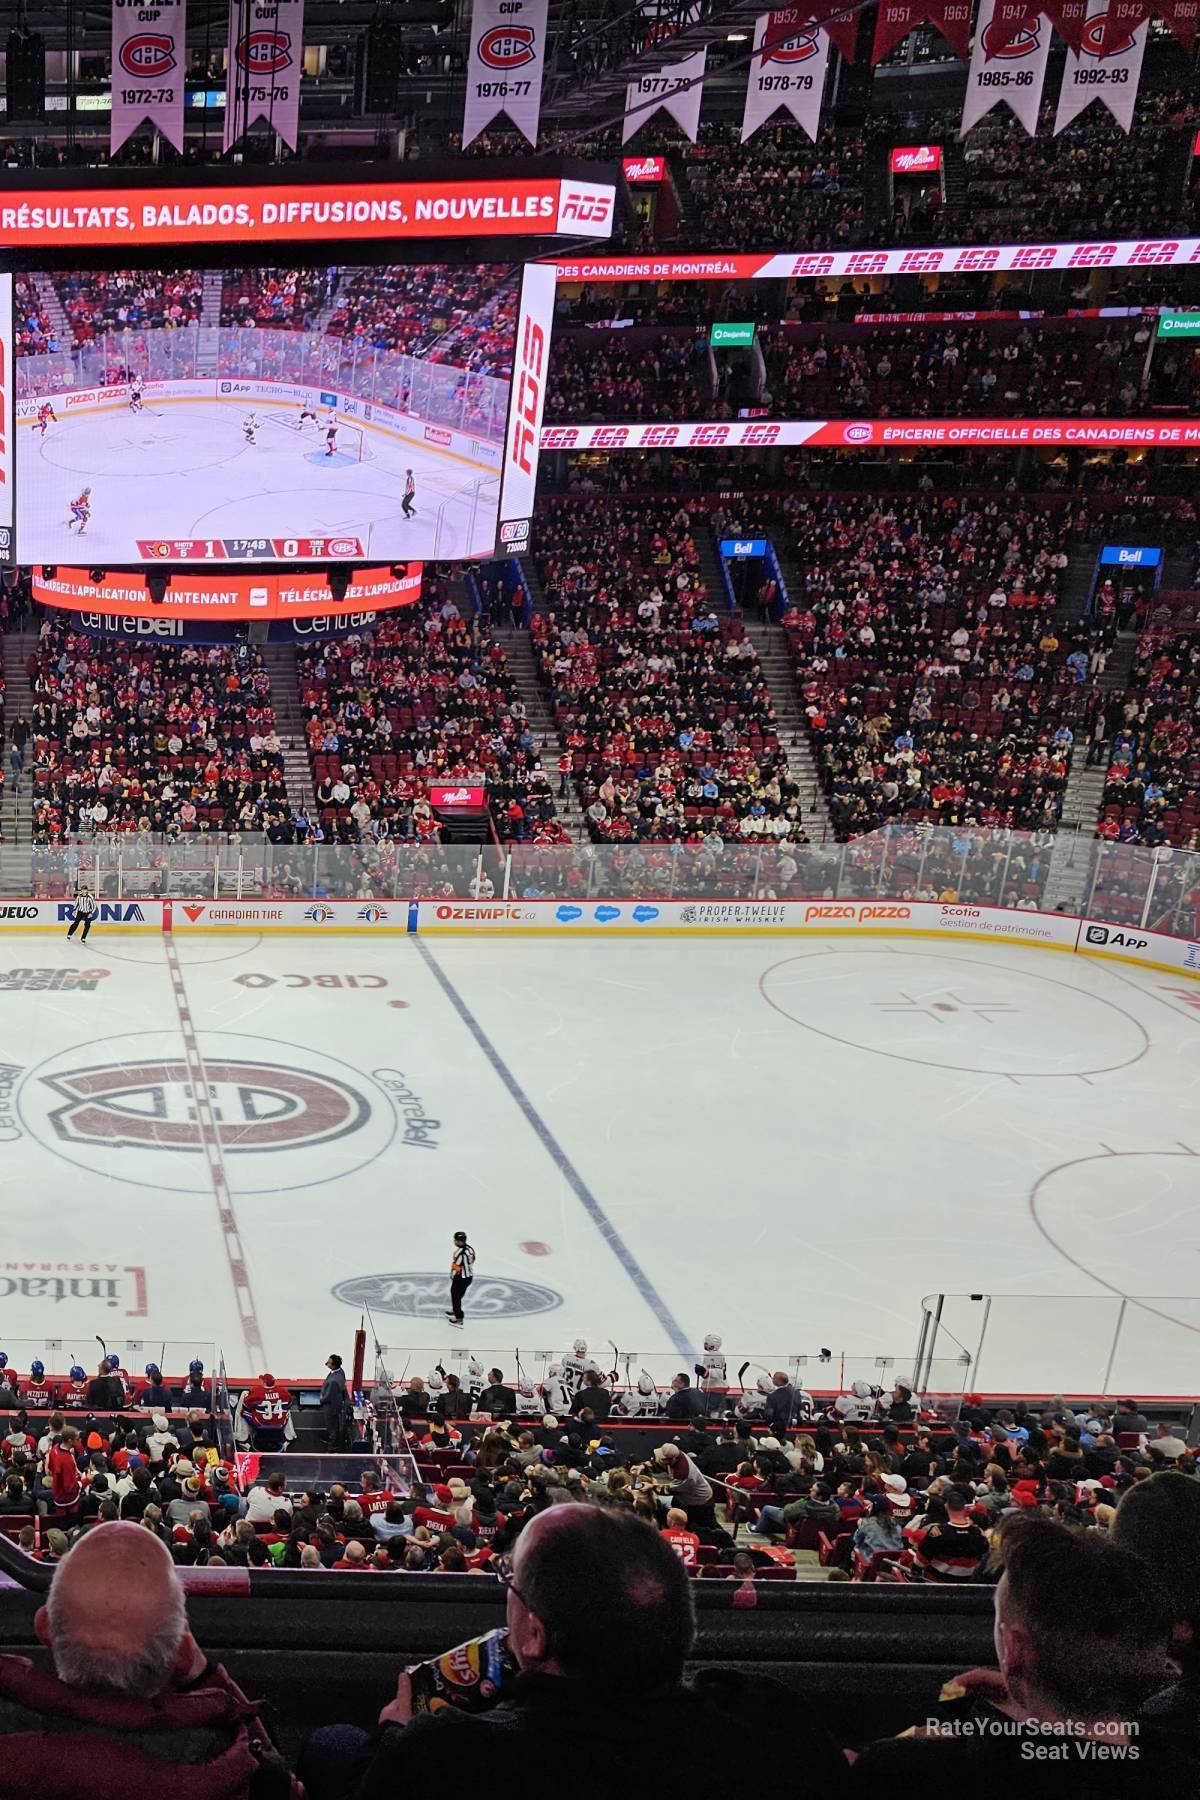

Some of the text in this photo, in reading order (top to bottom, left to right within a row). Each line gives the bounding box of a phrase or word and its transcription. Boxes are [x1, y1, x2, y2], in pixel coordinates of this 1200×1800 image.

[255, 6, 277, 20] CUP
[500, 2, 522, 14] CUP
[886, 7, 910, 22] 1951
[943, 6, 968, 20] 1963
[1001, 4, 1027, 19] 1947
[1116, 3, 1142, 17] 1942
[138, 10, 161, 22] CUP
[758, 75, 813, 91] 1978-79
[976, 71, 1033, 87] 1985-86
[1072, 68, 1128, 85] 1992-93
[121, 88, 173, 105] 1972-73
[476, 81, 531, 98] 1976-77
[2, 196, 554, 231] RÉSULTATS, BALADOS, DIFFUSIONS, NOUVELLES
[562, 194, 612, 222] RDS
[845, 253, 888, 274] IGA
[1009, 248, 1057, 268] IGA
[513, 314, 546, 475] RDS
[883, 426, 1155, 441] ÉPICERIE OFFICIELLE CANADIENS
[205, 542, 214, 557] 1
[233, 540, 266, 550] 17:48
[283, 540, 299, 556] 0
[311, 547, 322, 556] 11
[734, 542, 752, 554] Bell
[246, 549, 254, 557] 2
[1119, 550, 1142, 562] Bell
[71, 584, 238, 604] L'APPLICATION AINTENANT
[58, 904, 145, 921] RNA
[209, 909, 284, 920] CANADIAN TIRE
[699, 906, 786, 916] PROPER TWELVE
[805, 906, 911, 923] pizza pizza
[941, 905, 980, 918] Scotia
[939, 917, 993, 930] Gestion de
[285, 974, 388, 988] CIBC
[371, 1067, 440, 1149] CentreBell
[263, 1401, 284, 1420] 34
